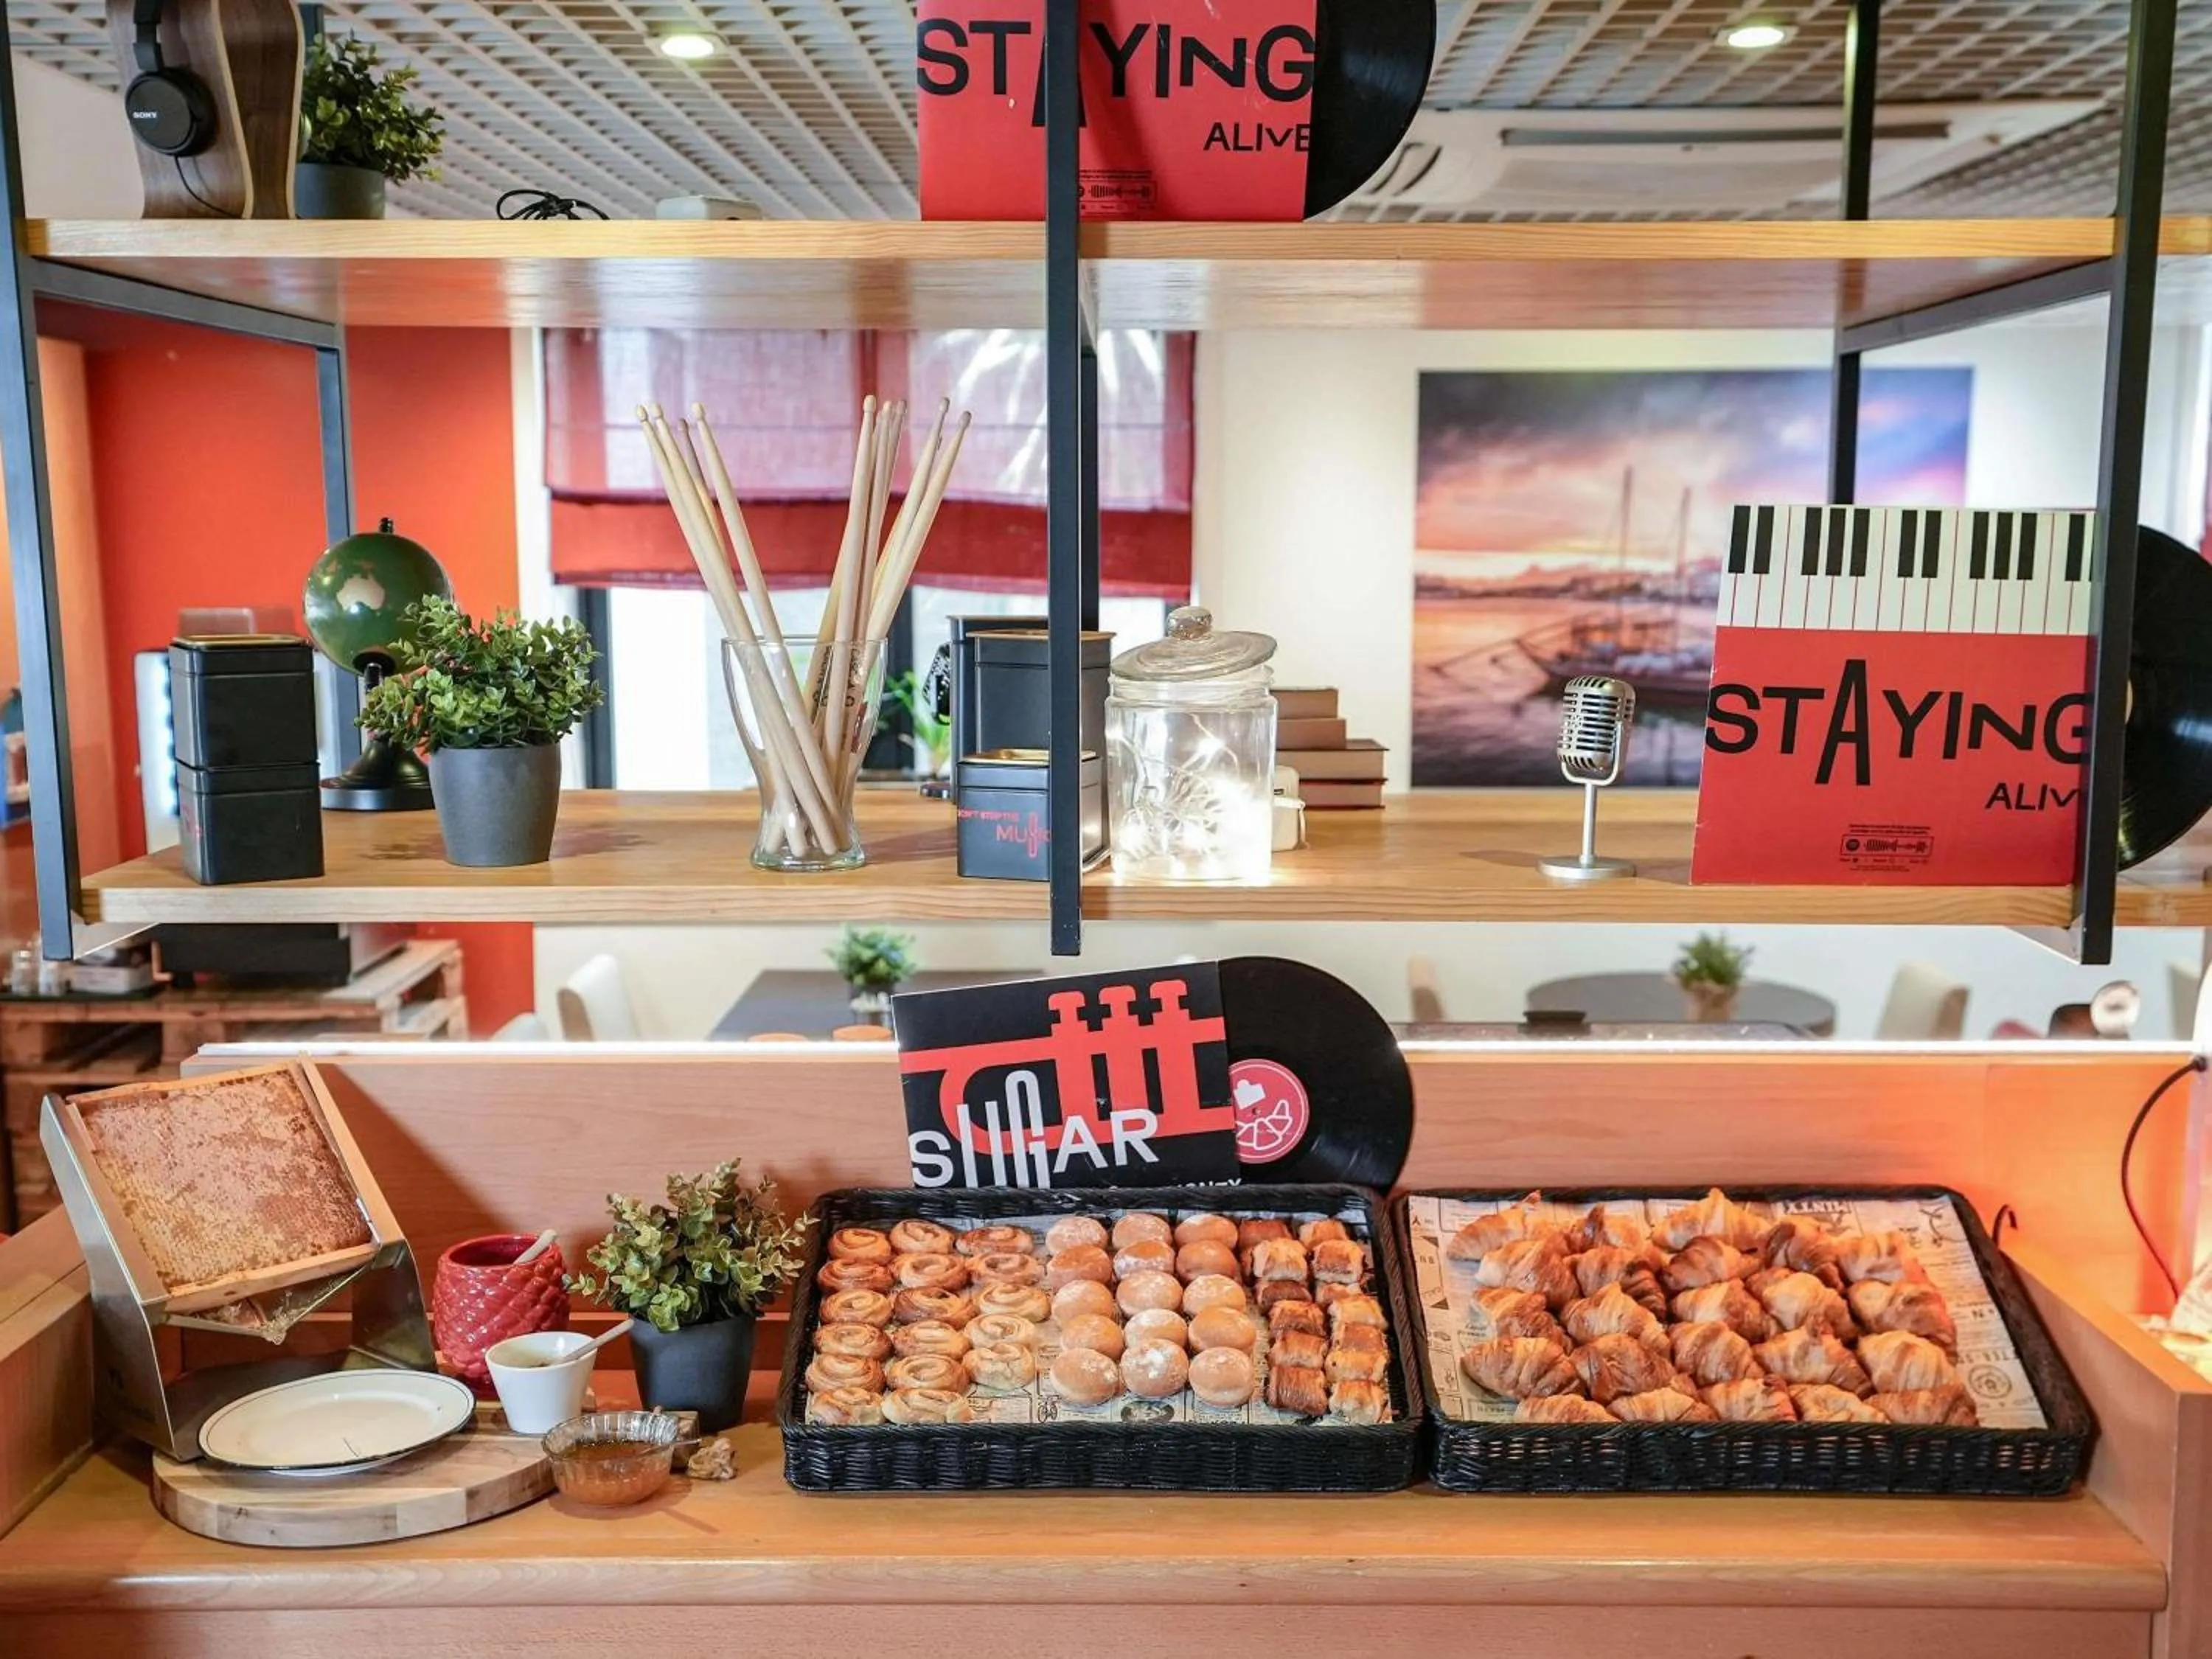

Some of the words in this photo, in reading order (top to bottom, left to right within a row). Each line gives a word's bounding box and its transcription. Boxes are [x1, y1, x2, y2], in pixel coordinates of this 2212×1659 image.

[1203, 122, 1311, 152] ALIVE
[1704, 658, 2096, 786] STAYING
[1985, 782, 2081, 810] ALIV
